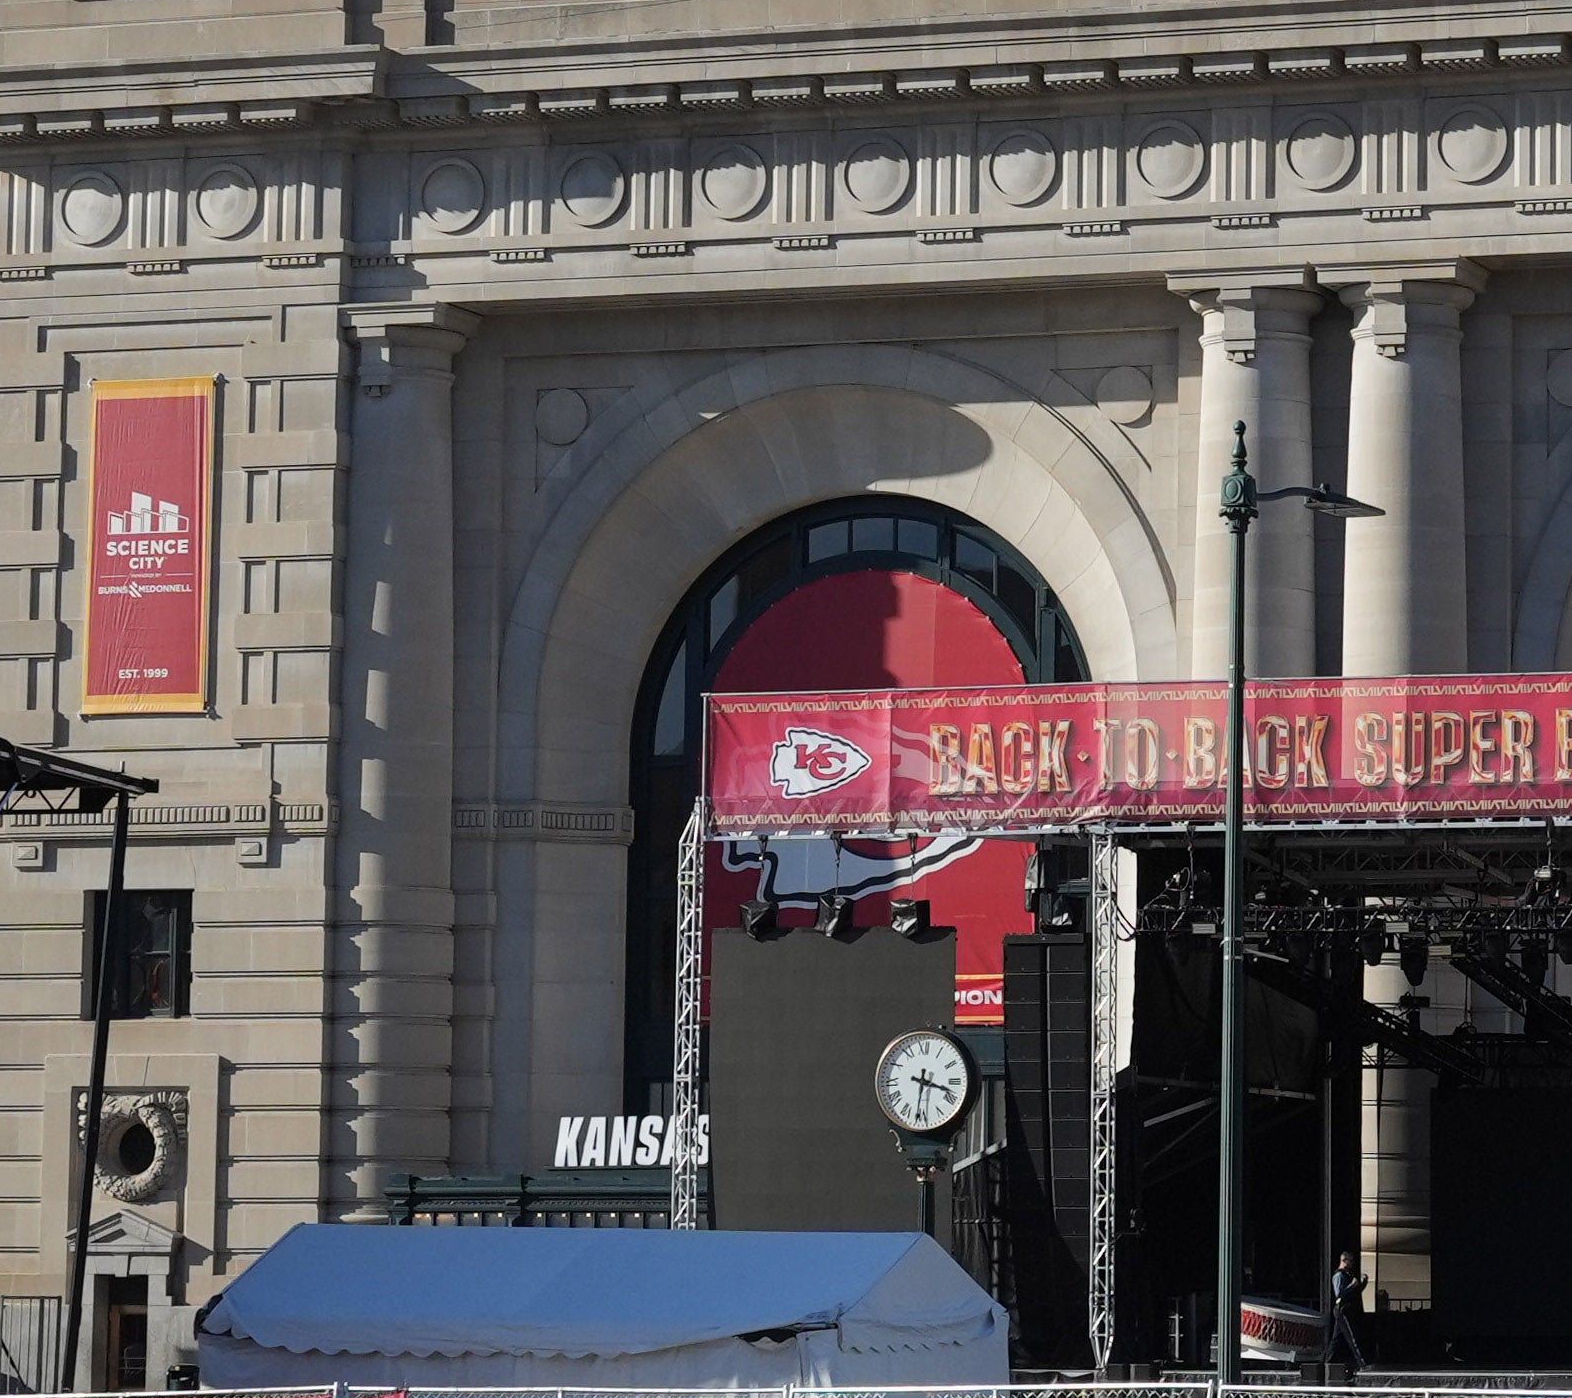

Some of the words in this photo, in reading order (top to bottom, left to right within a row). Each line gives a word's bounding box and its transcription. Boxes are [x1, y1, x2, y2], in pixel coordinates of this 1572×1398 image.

[106, 539, 189, 556] SCIENCE
[129, 557, 165, 570] CITY
[98, 585, 128, 595] BURNS
[118, 669, 140, 678] EST.
[143, 668, 168, 678] 1999
[929, 718, 1070, 795] BACK
[1093, 715, 1161, 792] TO
[1354, 711, 1535, 788] SUPER
[794, 743, 847, 780] KC
